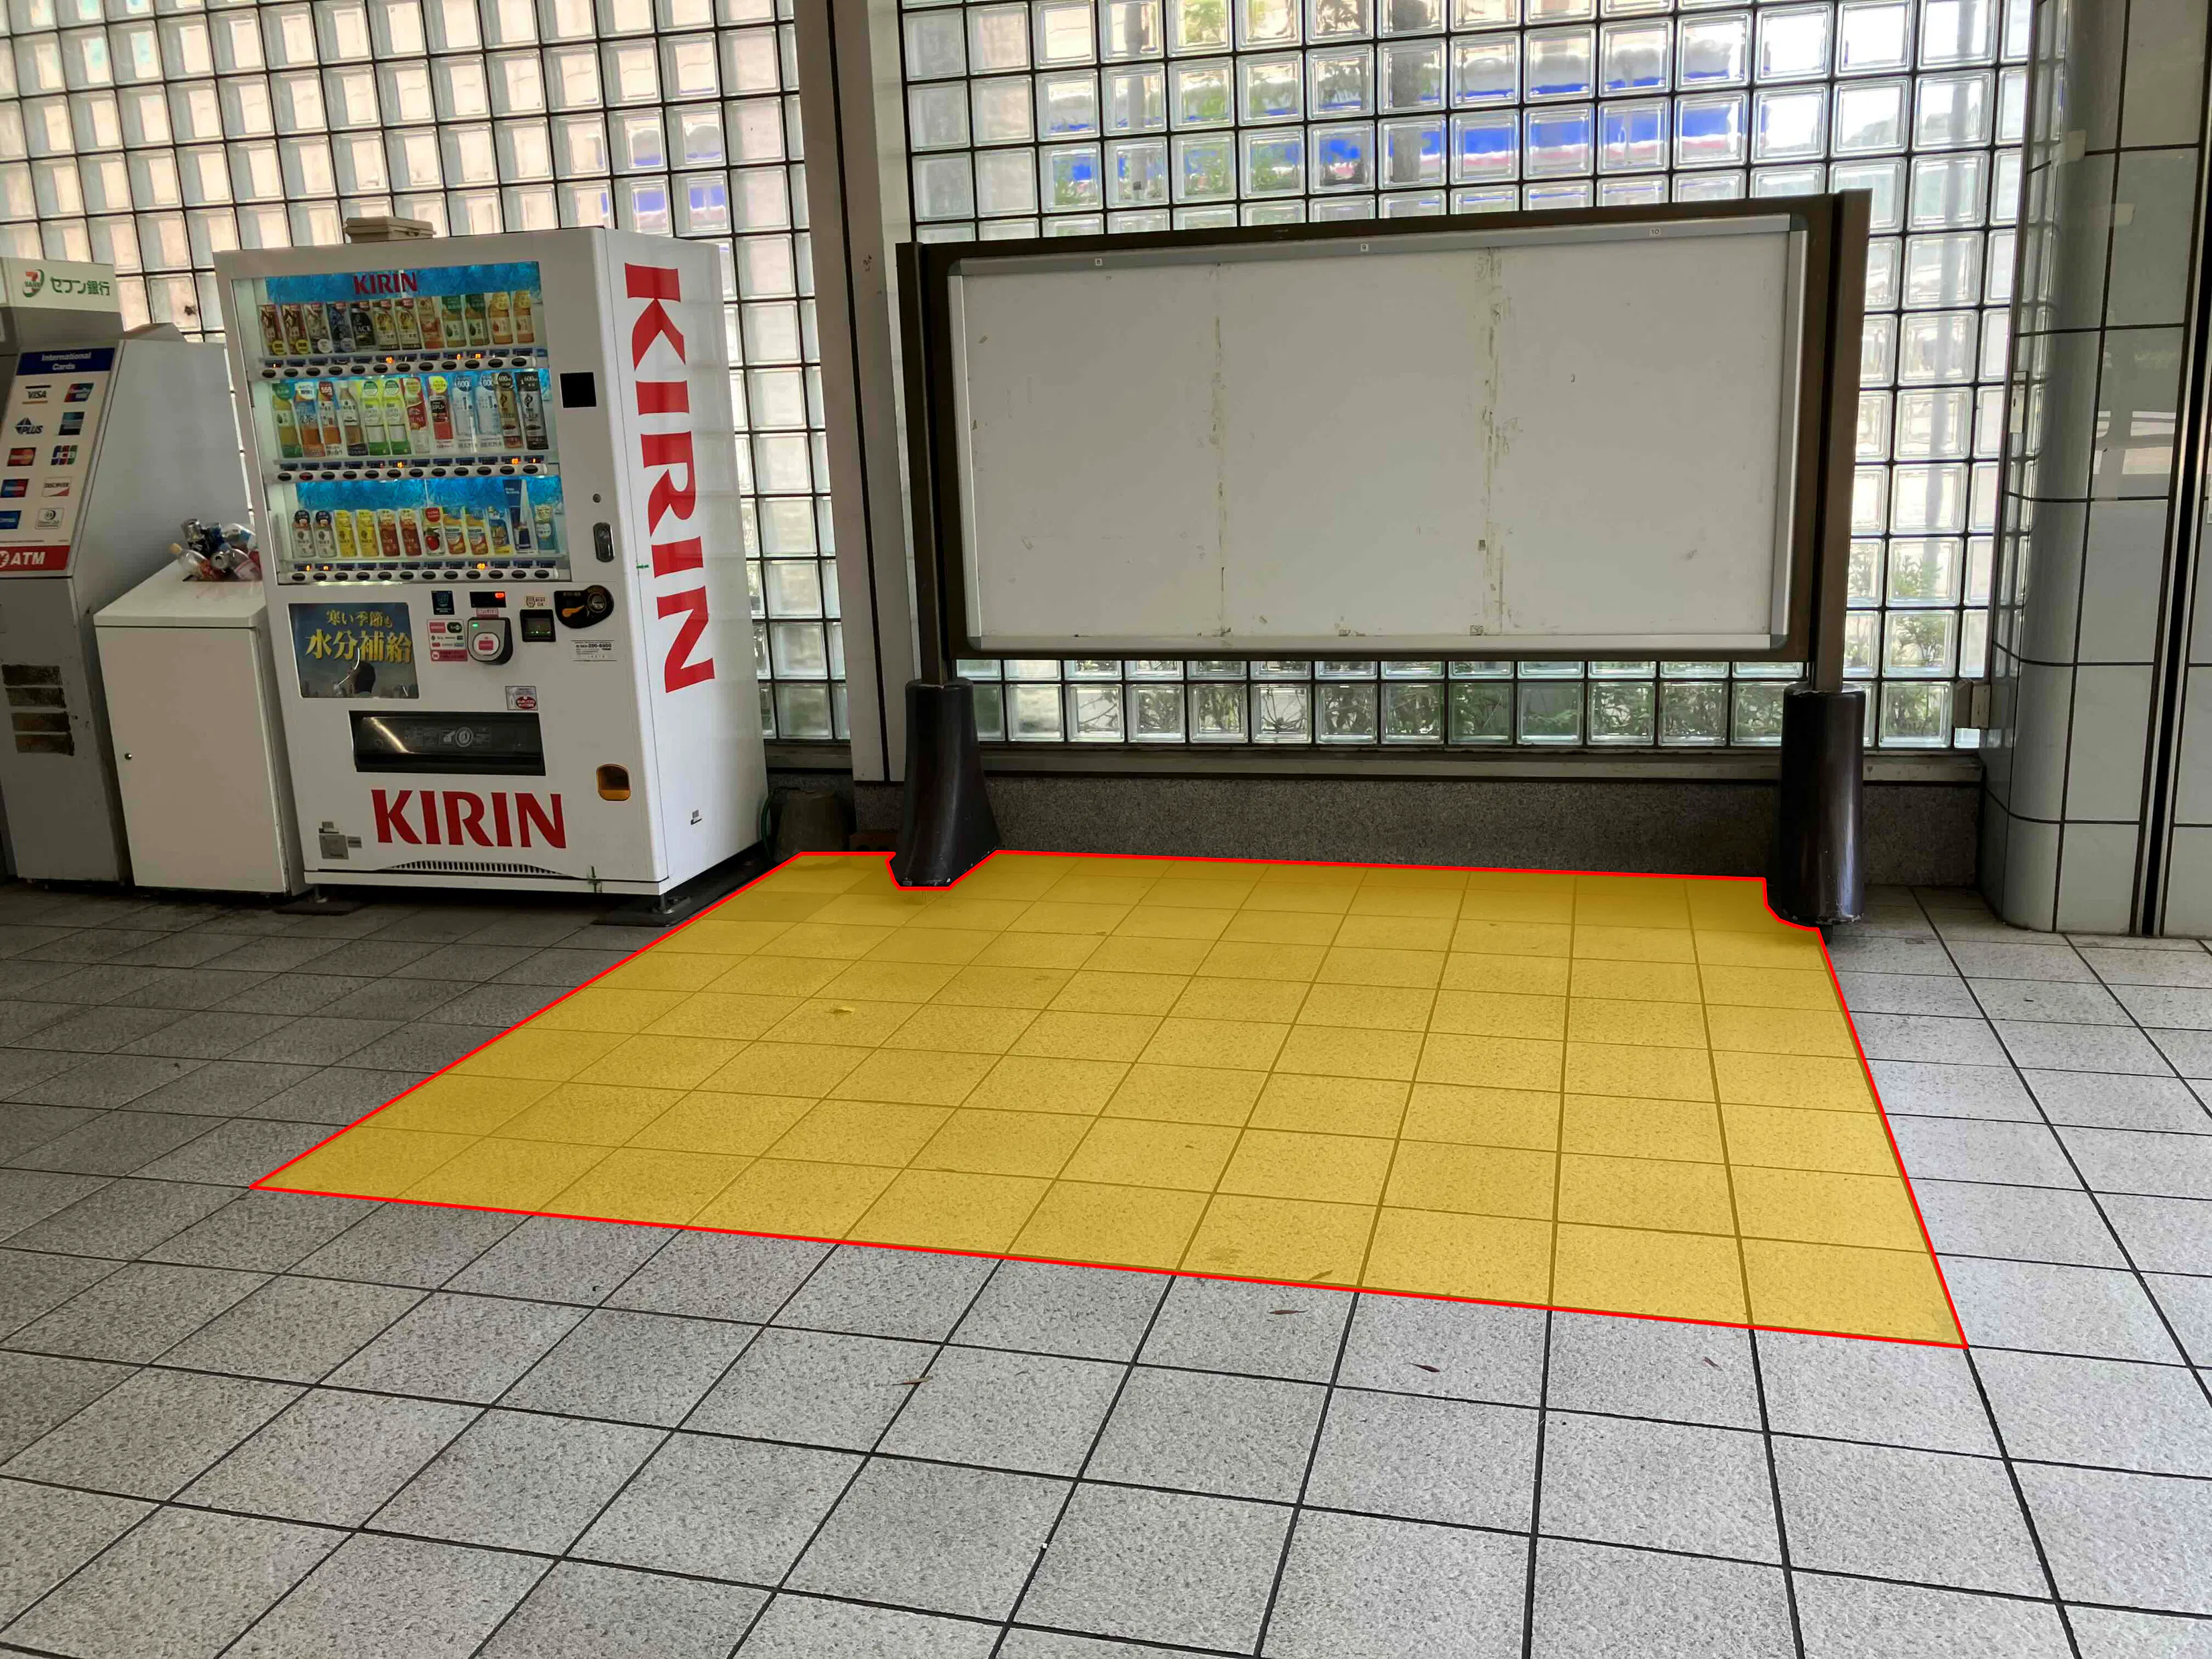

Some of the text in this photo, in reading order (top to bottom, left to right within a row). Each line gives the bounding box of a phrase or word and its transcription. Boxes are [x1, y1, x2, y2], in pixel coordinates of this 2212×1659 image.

[50, 276, 111, 296] セブン銀行
[353, 271, 418, 295] KIRIN
[41, 352, 93, 361] International
[27, 390, 47, 399] VISA
[21, 425, 44, 434] PLUS
[52, 451, 75, 459] JCB
[624, 263, 715, 693] KIRIN
[10, 552, 46, 566] ATM
[326, 609, 393, 628] 寒い季節も
[305, 629, 413, 664] 水分補給
[371, 789, 566, 849] KIRIN
